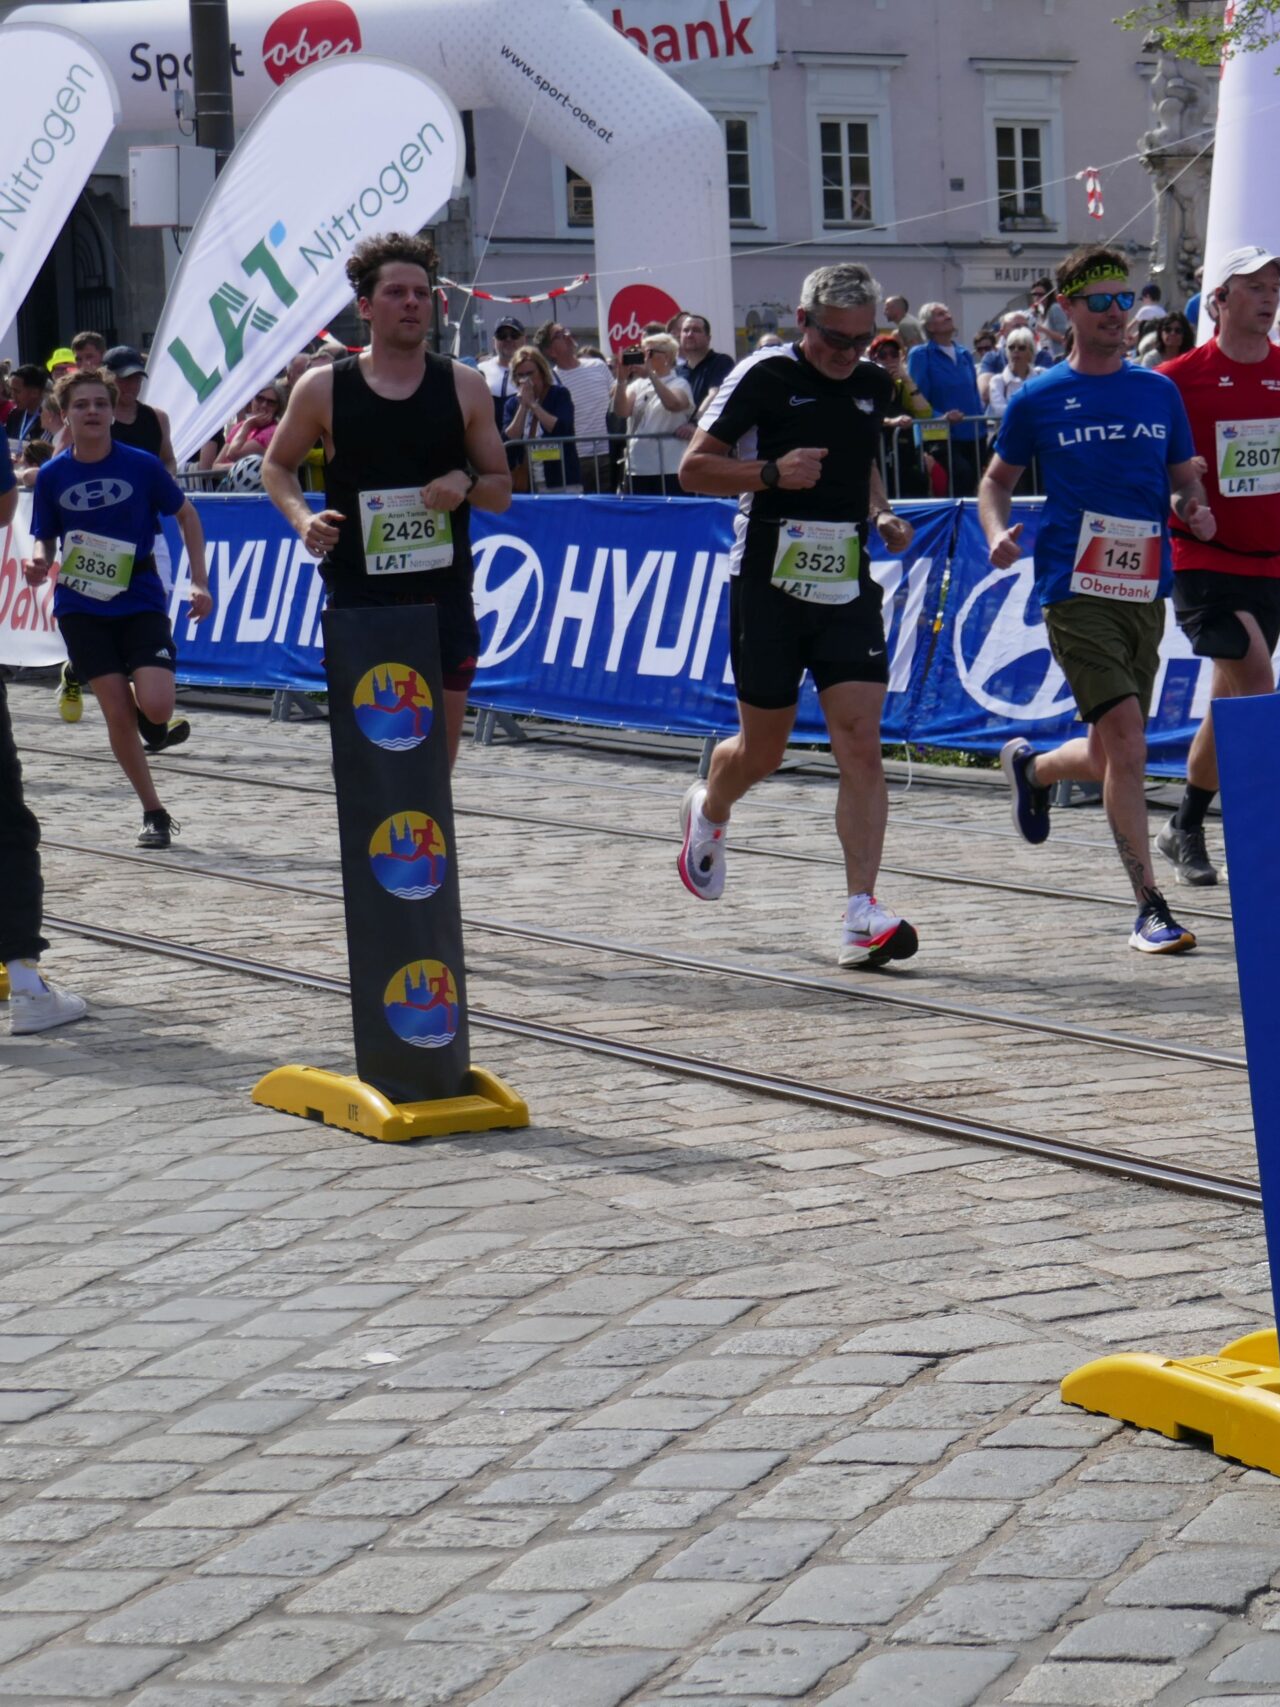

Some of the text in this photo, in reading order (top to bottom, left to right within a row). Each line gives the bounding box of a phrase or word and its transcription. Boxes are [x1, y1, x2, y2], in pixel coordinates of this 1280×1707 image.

[612, 0, 754, 64] bank
[130, 42, 244, 91] Spt
[500, 44, 615, 144] www.sport-ooe.at
[0, 63, 94, 231] Nitrogen
[166, 121, 445, 405] LAT Nitrogen
[1058, 423, 1166, 446] LINZ AG
[1235, 448, 1280, 468] 2807
[1228, 479, 1256, 493] LAT
[382, 519, 435, 542] 2426
[75, 555, 117, 578] 3836
[376, 553, 407, 571] LAT
[794, 551, 846, 574] 3523
[1105, 548, 1141, 570] 145
[168, 538, 323, 648] HYUN
[1080, 577, 1151, 598] Oberbank
